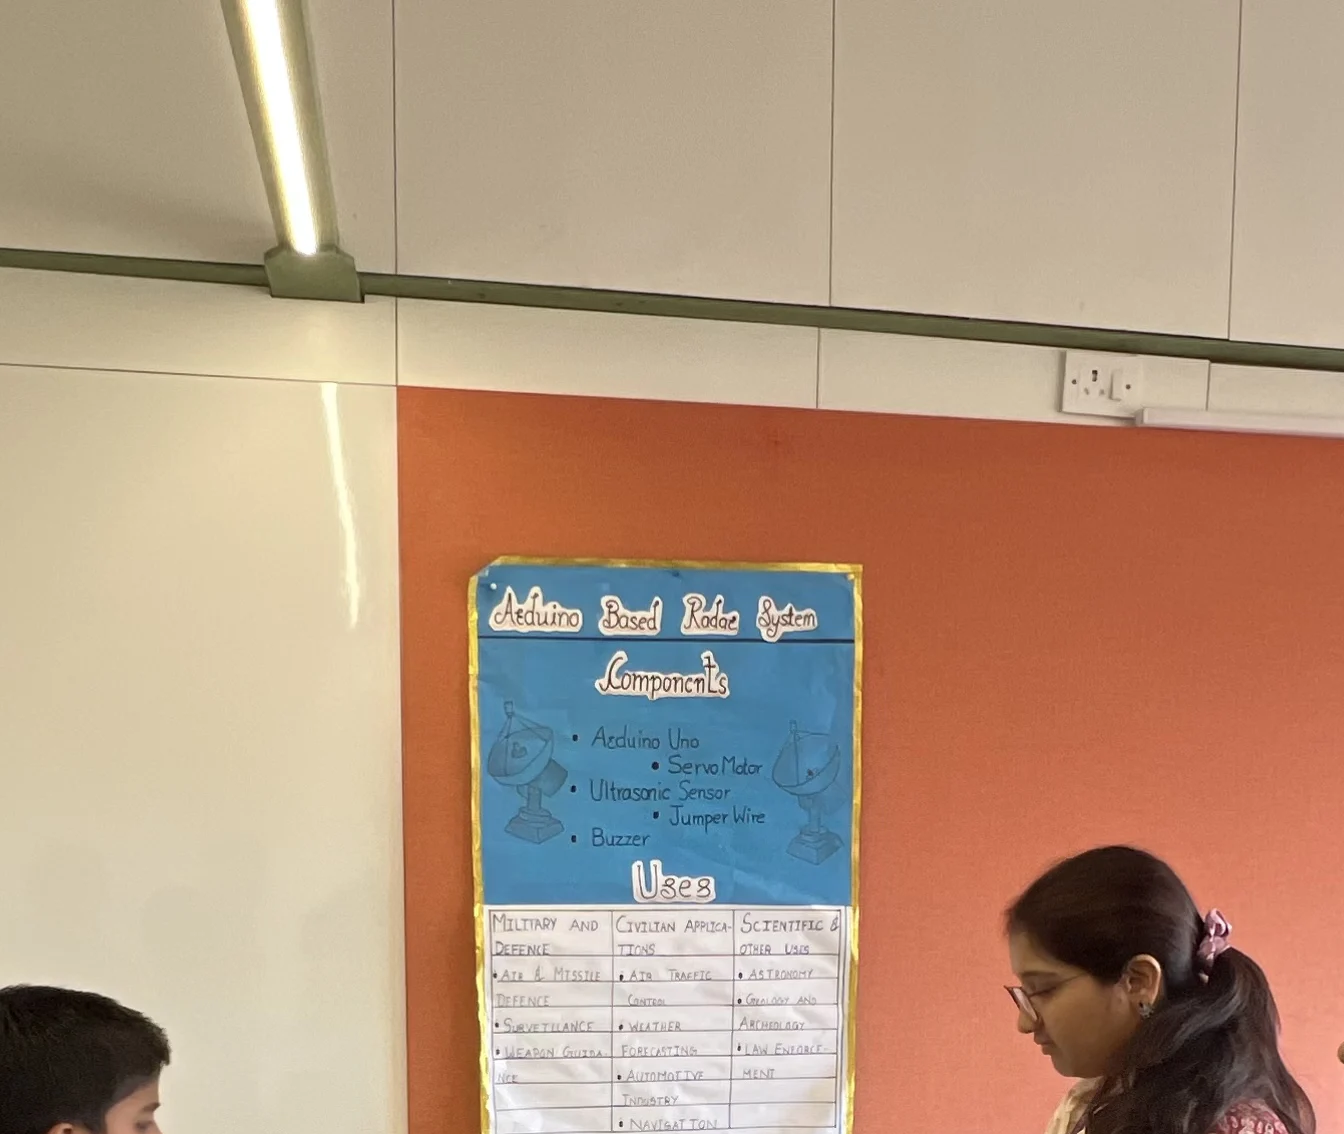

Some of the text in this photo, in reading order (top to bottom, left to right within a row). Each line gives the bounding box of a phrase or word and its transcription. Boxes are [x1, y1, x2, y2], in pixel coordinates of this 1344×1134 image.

[602, 600, 659, 631] Based
[684, 596, 738, 631] Radar
[758, 599, 816, 638] System
[668, 727, 700, 750] Uno
[668, 754, 763, 775] Servo Motor
[589, 778, 731, 801] Ultrasonic Sensor
[669, 805, 766, 833] Jumper Wire
[592, 828, 650, 846] Buzzer
[637, 864, 711, 899] Uses
[569, 919, 599, 932] AND
